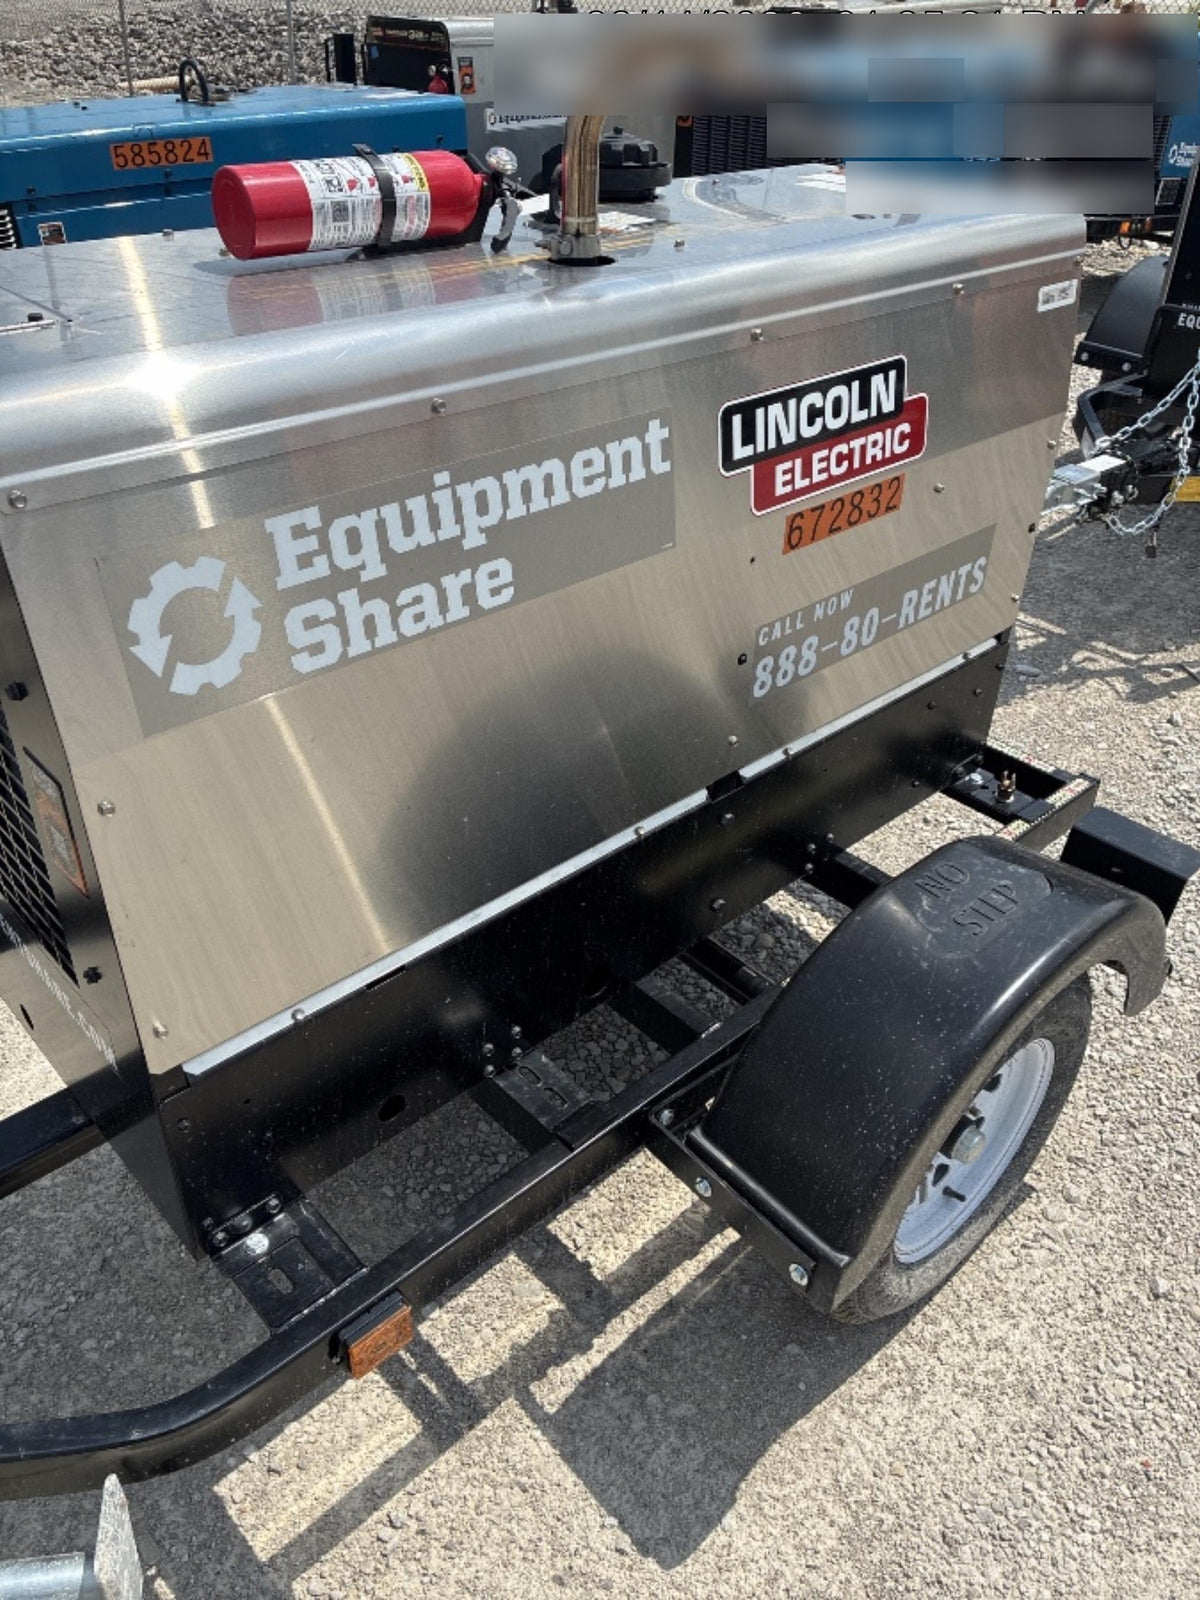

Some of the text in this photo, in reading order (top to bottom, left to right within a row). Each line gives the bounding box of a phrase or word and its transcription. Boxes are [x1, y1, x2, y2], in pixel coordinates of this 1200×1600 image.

[112, 138, 210, 168] 585824
[732, 369, 897, 461] LINCOLN
[774, 422, 912, 497] ELECTRIC
[264, 418, 672, 590] Equipment
[786, 475, 902, 551] 672832
[284, 557, 515, 674] Share
[753, 556, 987, 698] 888-80-RENTS
[758, 589, 855, 647] CALL NOW
[914, 862, 970, 901] NO
[952, 883, 1018, 937] STEP
